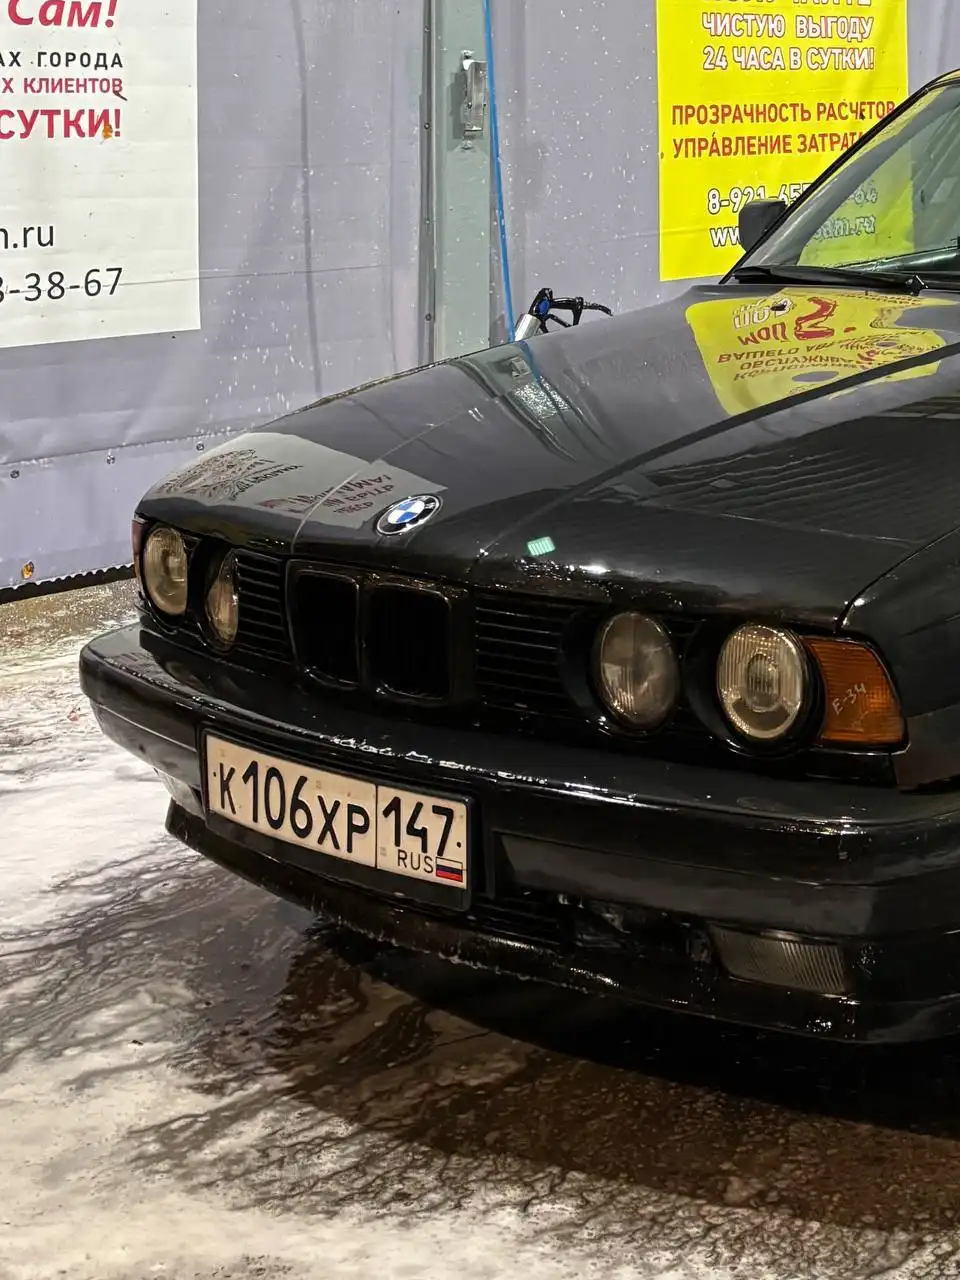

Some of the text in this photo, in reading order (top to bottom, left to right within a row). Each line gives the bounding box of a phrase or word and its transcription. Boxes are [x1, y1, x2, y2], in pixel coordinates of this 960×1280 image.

[702, 12, 875, 43] ЧИСТУЮ ВЫГОДУ
[37, 52, 123, 71] ГОРОДА
[703, 45, 875, 71] 24 ЧАСА В СУТКИ!
[23, 77, 123, 95] КЛИЕНТОВ
[0, 109, 121, 139] СУТКИ!
[672, 102, 812, 126] ПРОЗРАЧНОСТЬ
[673, 131, 863, 159] УПРАВЛЕНИЕ ЗАТРАТ
[219, 760, 455, 857] К106ХР 147
[397, 849, 434, 874] RUS
